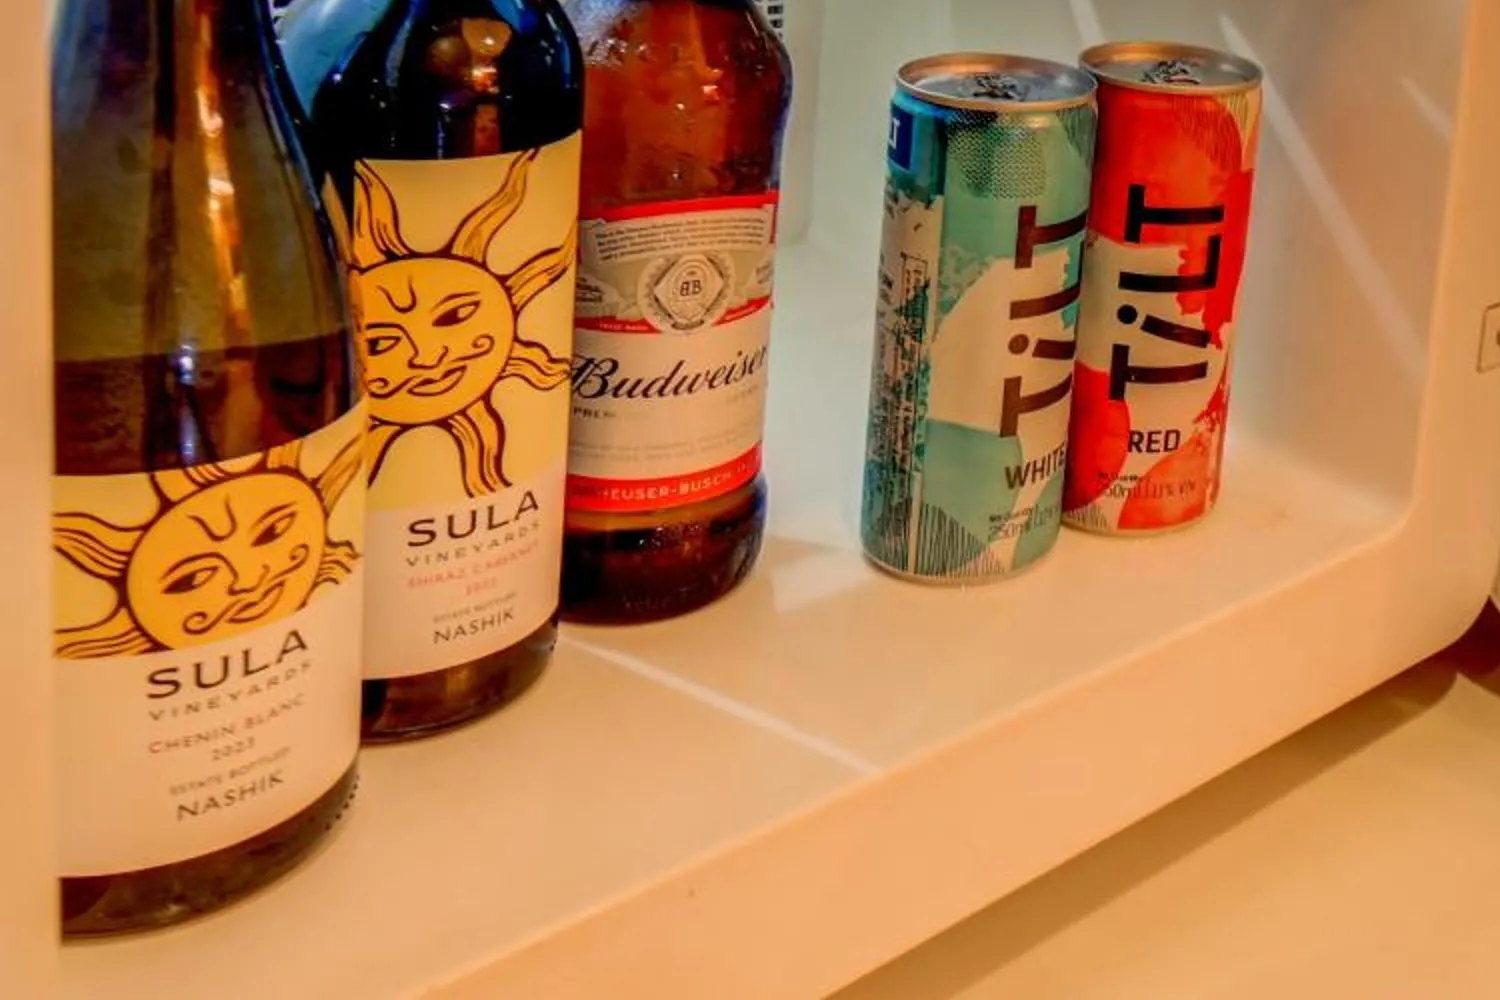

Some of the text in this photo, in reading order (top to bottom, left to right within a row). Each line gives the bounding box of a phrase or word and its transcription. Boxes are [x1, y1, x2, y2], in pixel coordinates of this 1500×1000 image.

[571, 346, 767, 399] Budweiser
[1127, 429, 1181, 454] RED
[405, 519, 540, 567] VINEYARDS
[407, 490, 539, 547] SULA
[433, 606, 515, 645] NASHIK
[146, 628, 308, 699] SULA
[148, 659, 311, 721] VINEYARDS
[148, 692, 304, 754] CHENIN BLANC
[176, 768, 284, 822] NASHIK
